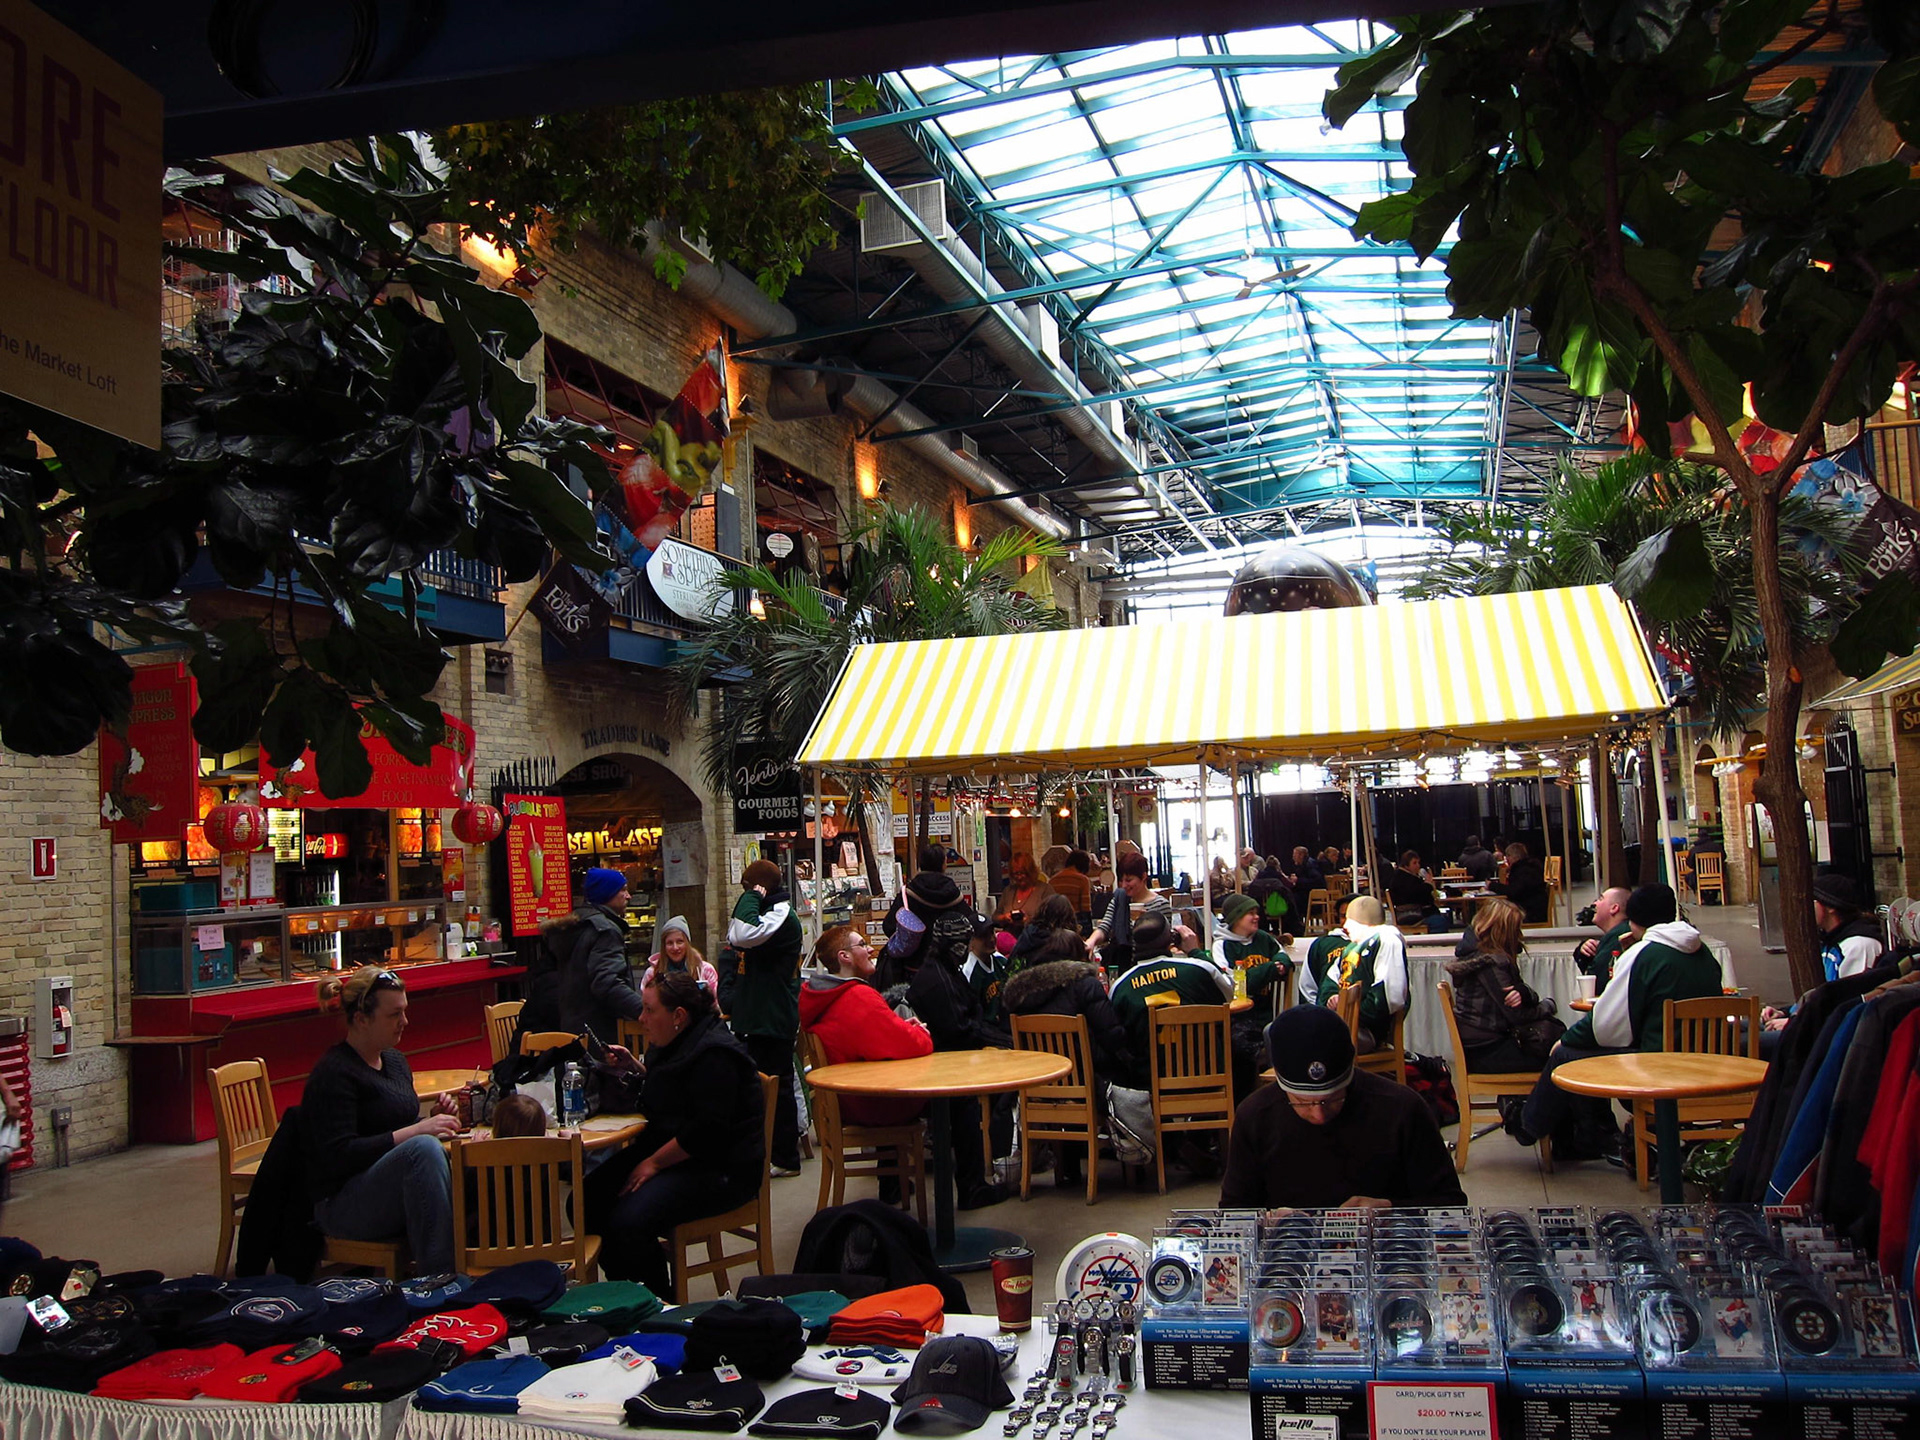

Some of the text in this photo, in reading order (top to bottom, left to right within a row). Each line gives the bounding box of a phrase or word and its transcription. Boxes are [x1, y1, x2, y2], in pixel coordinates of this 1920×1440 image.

[0, 177, 119, 310] LOOR
[0, 329, 118, 396] he Market Loft
[660, 541, 726, 579] SOMETHING
[543, 583, 585, 634] Forks
[128, 706, 176, 724] XPRESS
[581, 724, 671, 757] TRADERS LANE
[591, 763, 629, 781] SHOP
[382, 789, 413, 803] FOOD
[738, 796, 799, 810] GOURMET
[509, 801, 560, 817] BUBBLE TEA
[758, 807, 799, 820] FOODS
[602, 829, 662, 850] PLEASE
[1131, 967, 1178, 990] HANTON
[1543, 1218, 1576, 1226] KINGS
[1211, 1243, 1242, 1251] JETS
[1395, 1391, 1465, 1399] CARD/PUCK GIFT SET
[1417, 1409, 1447, 1417] $20.00
[1388, 1428, 1403, 1436] YOU
[1403, 1428, 1424, 1436] DON'T
[1425, 1428, 1438, 1436] SEE
[1439, 1428, 1458, 1436] YOUR
[1459, 1428, 1486, 1437] PLAYER
